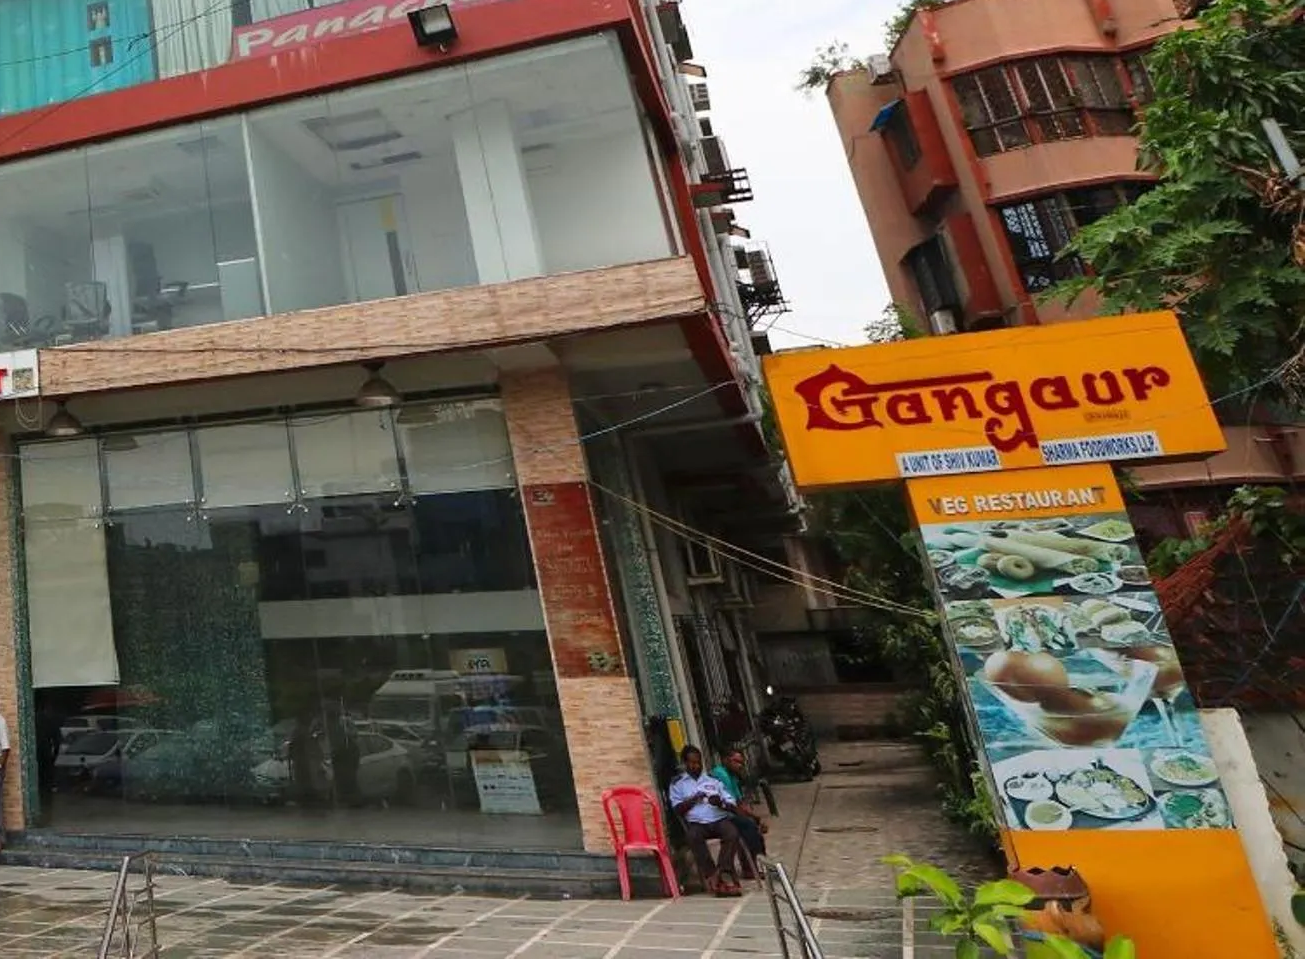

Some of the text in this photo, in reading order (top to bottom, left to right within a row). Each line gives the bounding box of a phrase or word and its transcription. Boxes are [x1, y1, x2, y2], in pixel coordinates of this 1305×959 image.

[795, 362, 1170, 453] Gangaur
[909, 454, 929, 472] UNIT
[965, 448, 999, 467] KUMAR
[1041, 442, 1080, 461] SHARMA
[1080, 436, 1138, 458] FOODWORKS
[928, 487, 1104, 515] VEG RESTAURANT
